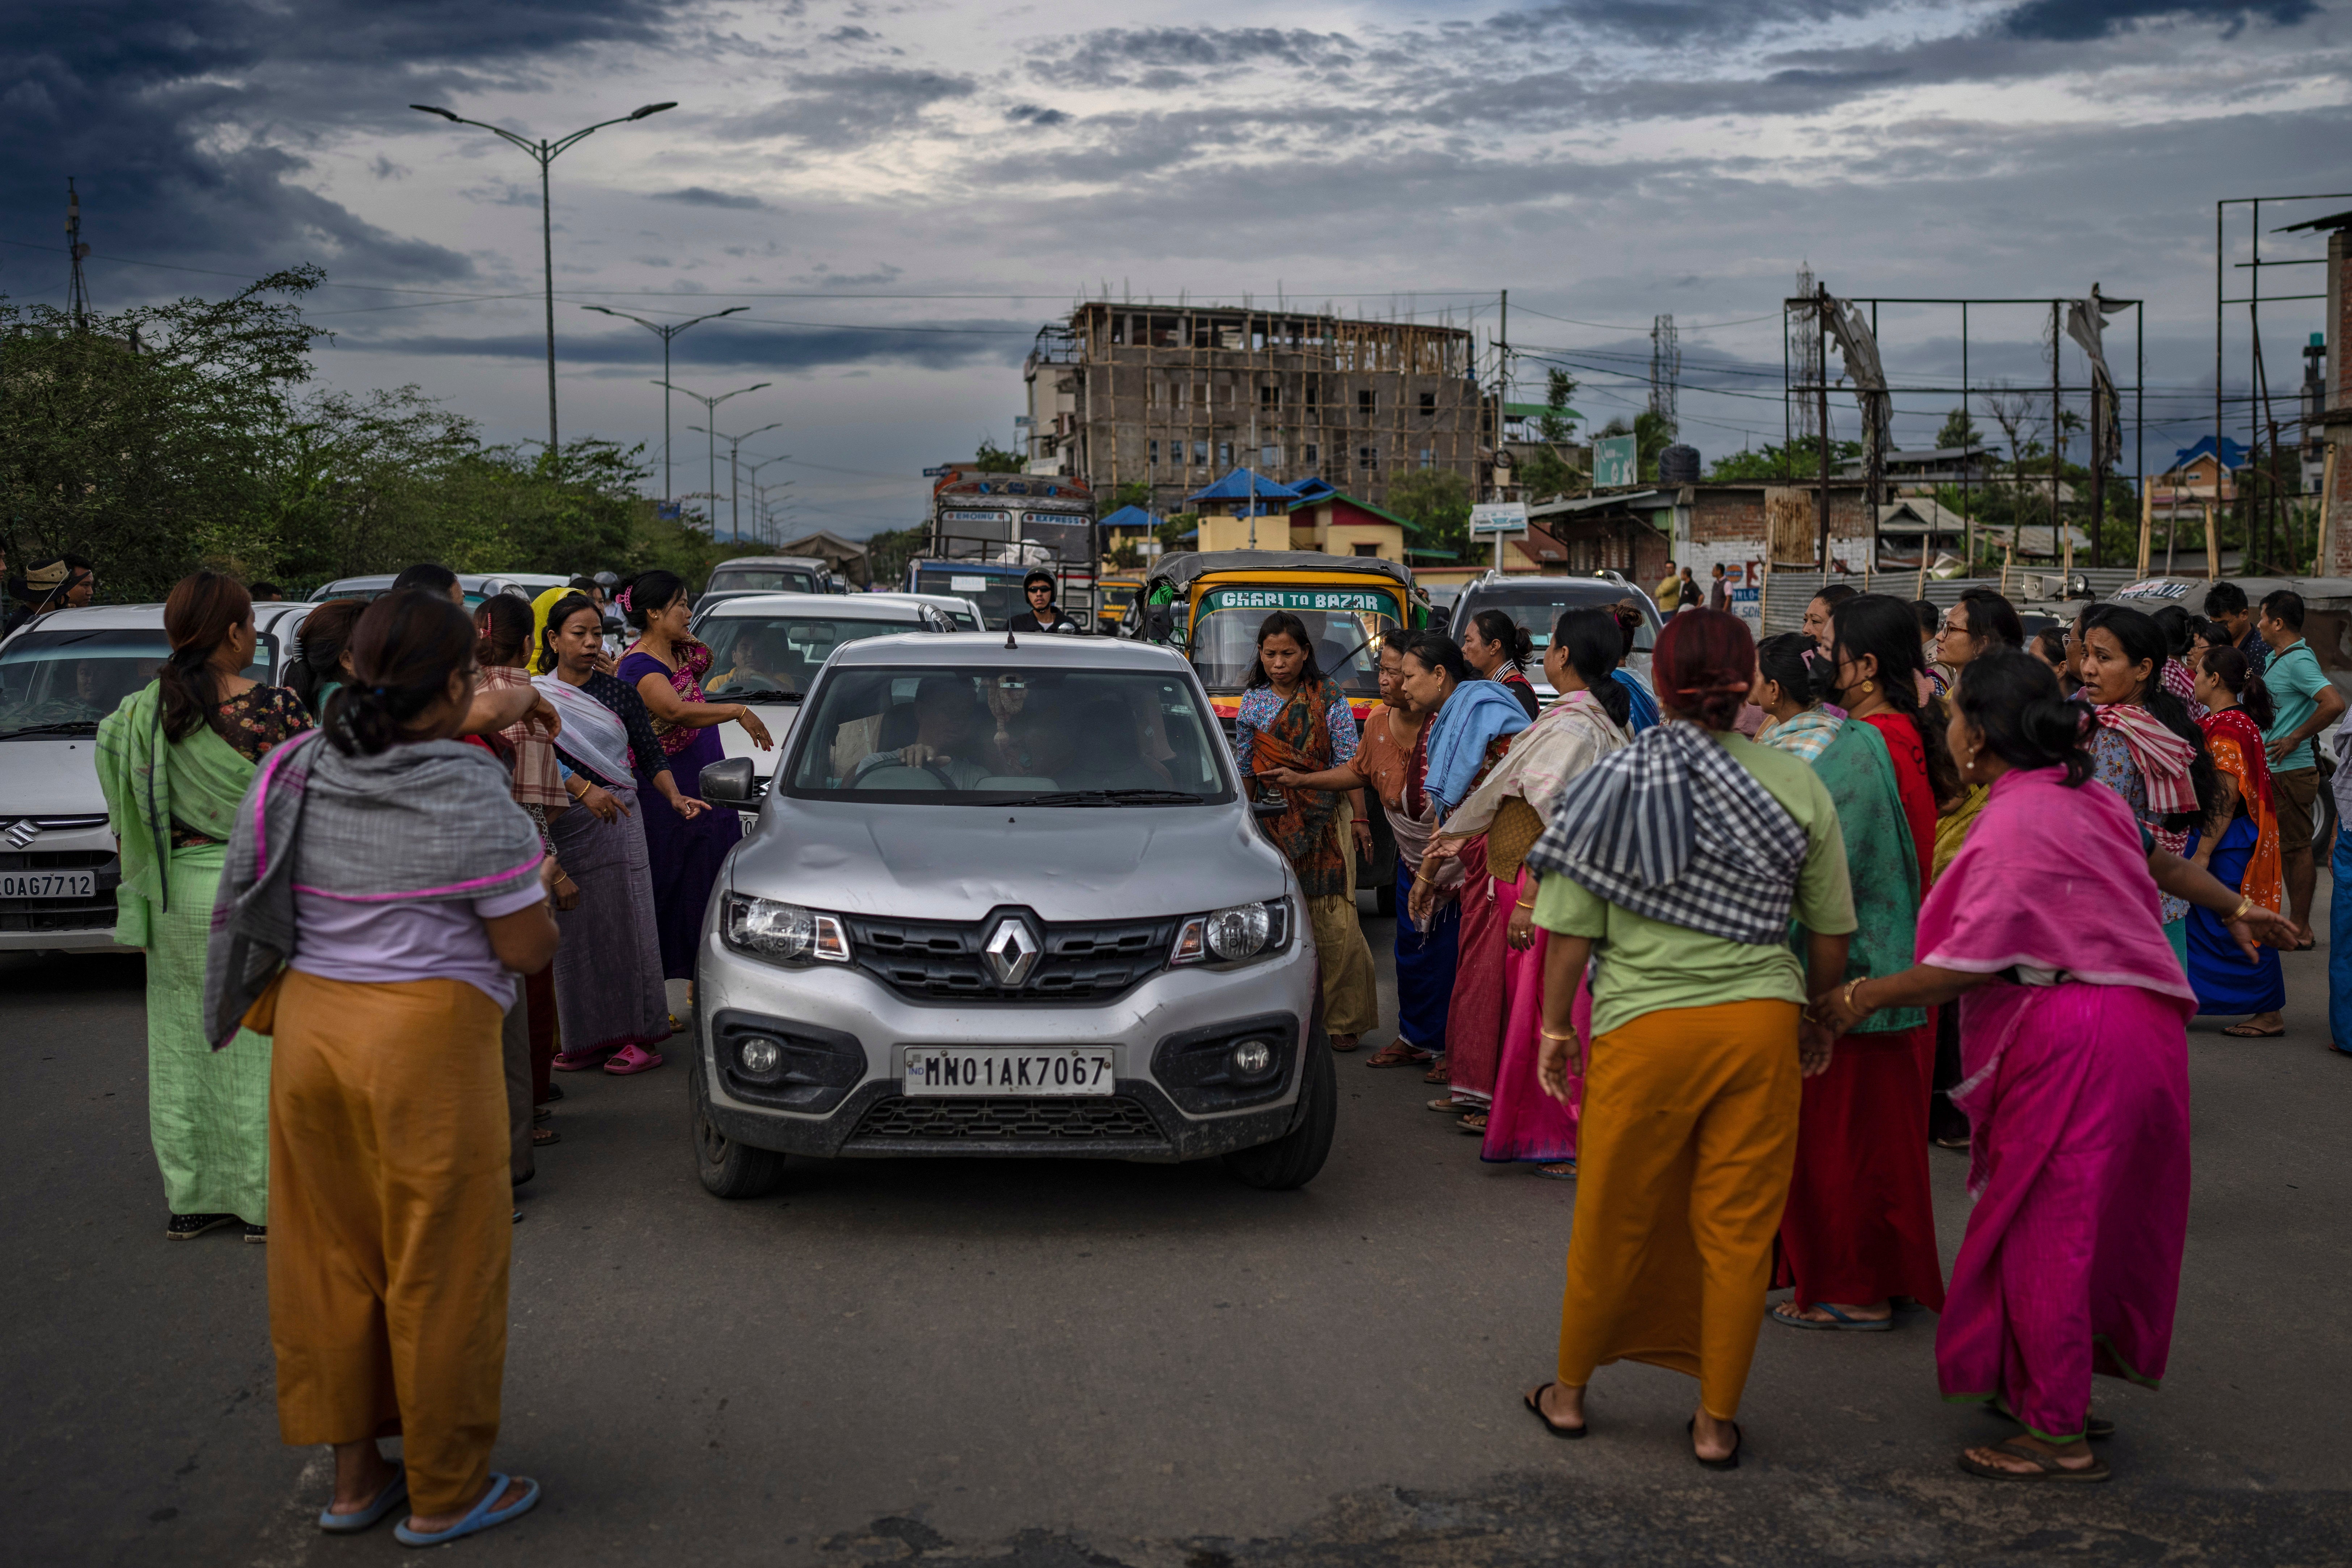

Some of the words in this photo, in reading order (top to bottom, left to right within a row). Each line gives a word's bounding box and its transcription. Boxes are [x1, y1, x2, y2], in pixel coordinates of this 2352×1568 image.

[1035, 515, 1079, 524] EXPRESS
[1222, 592, 1283, 607] GHARI
[1290, 595, 1308, 605] TO
[1315, 594, 1378, 610] BAZAR
[0, 876, 90, 895] 0AG7712
[908, 1067, 924, 1075] IND
[925, 1057, 1105, 1086] MN01AK7067
